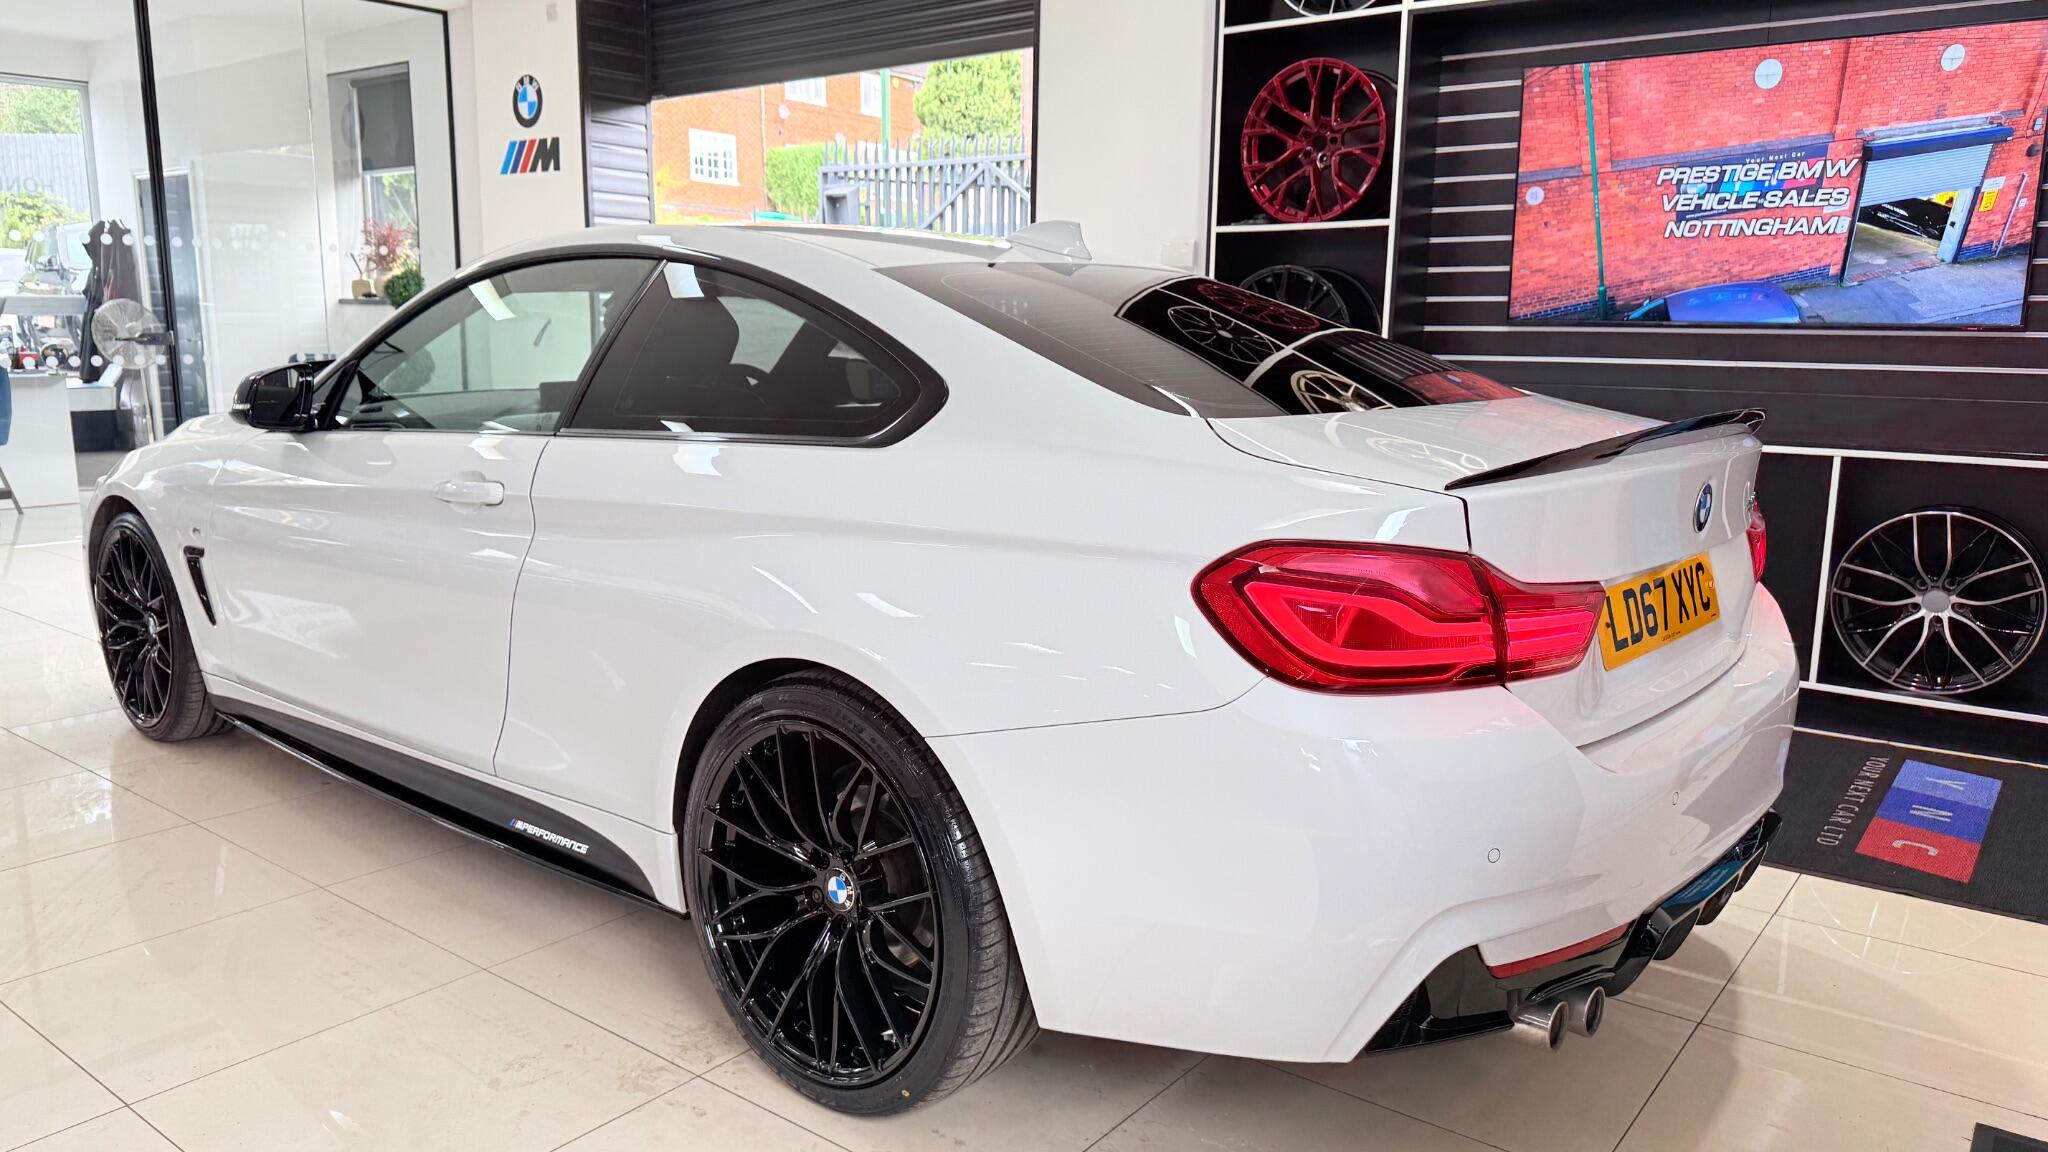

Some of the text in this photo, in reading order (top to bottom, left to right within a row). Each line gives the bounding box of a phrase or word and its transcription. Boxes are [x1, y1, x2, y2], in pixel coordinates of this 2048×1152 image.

[1657, 164, 1775, 185] PRESTIGE
[1778, 158, 1859, 180] BMW
[1662, 187, 1850, 212] VEHICLE SALES
[1664, 217, 1838, 238] NOTTINGHAM
[1606, 561, 1711, 652] LD67 XYC
[1816, 756, 1889, 847] YOUR NEXT CAR LTD
